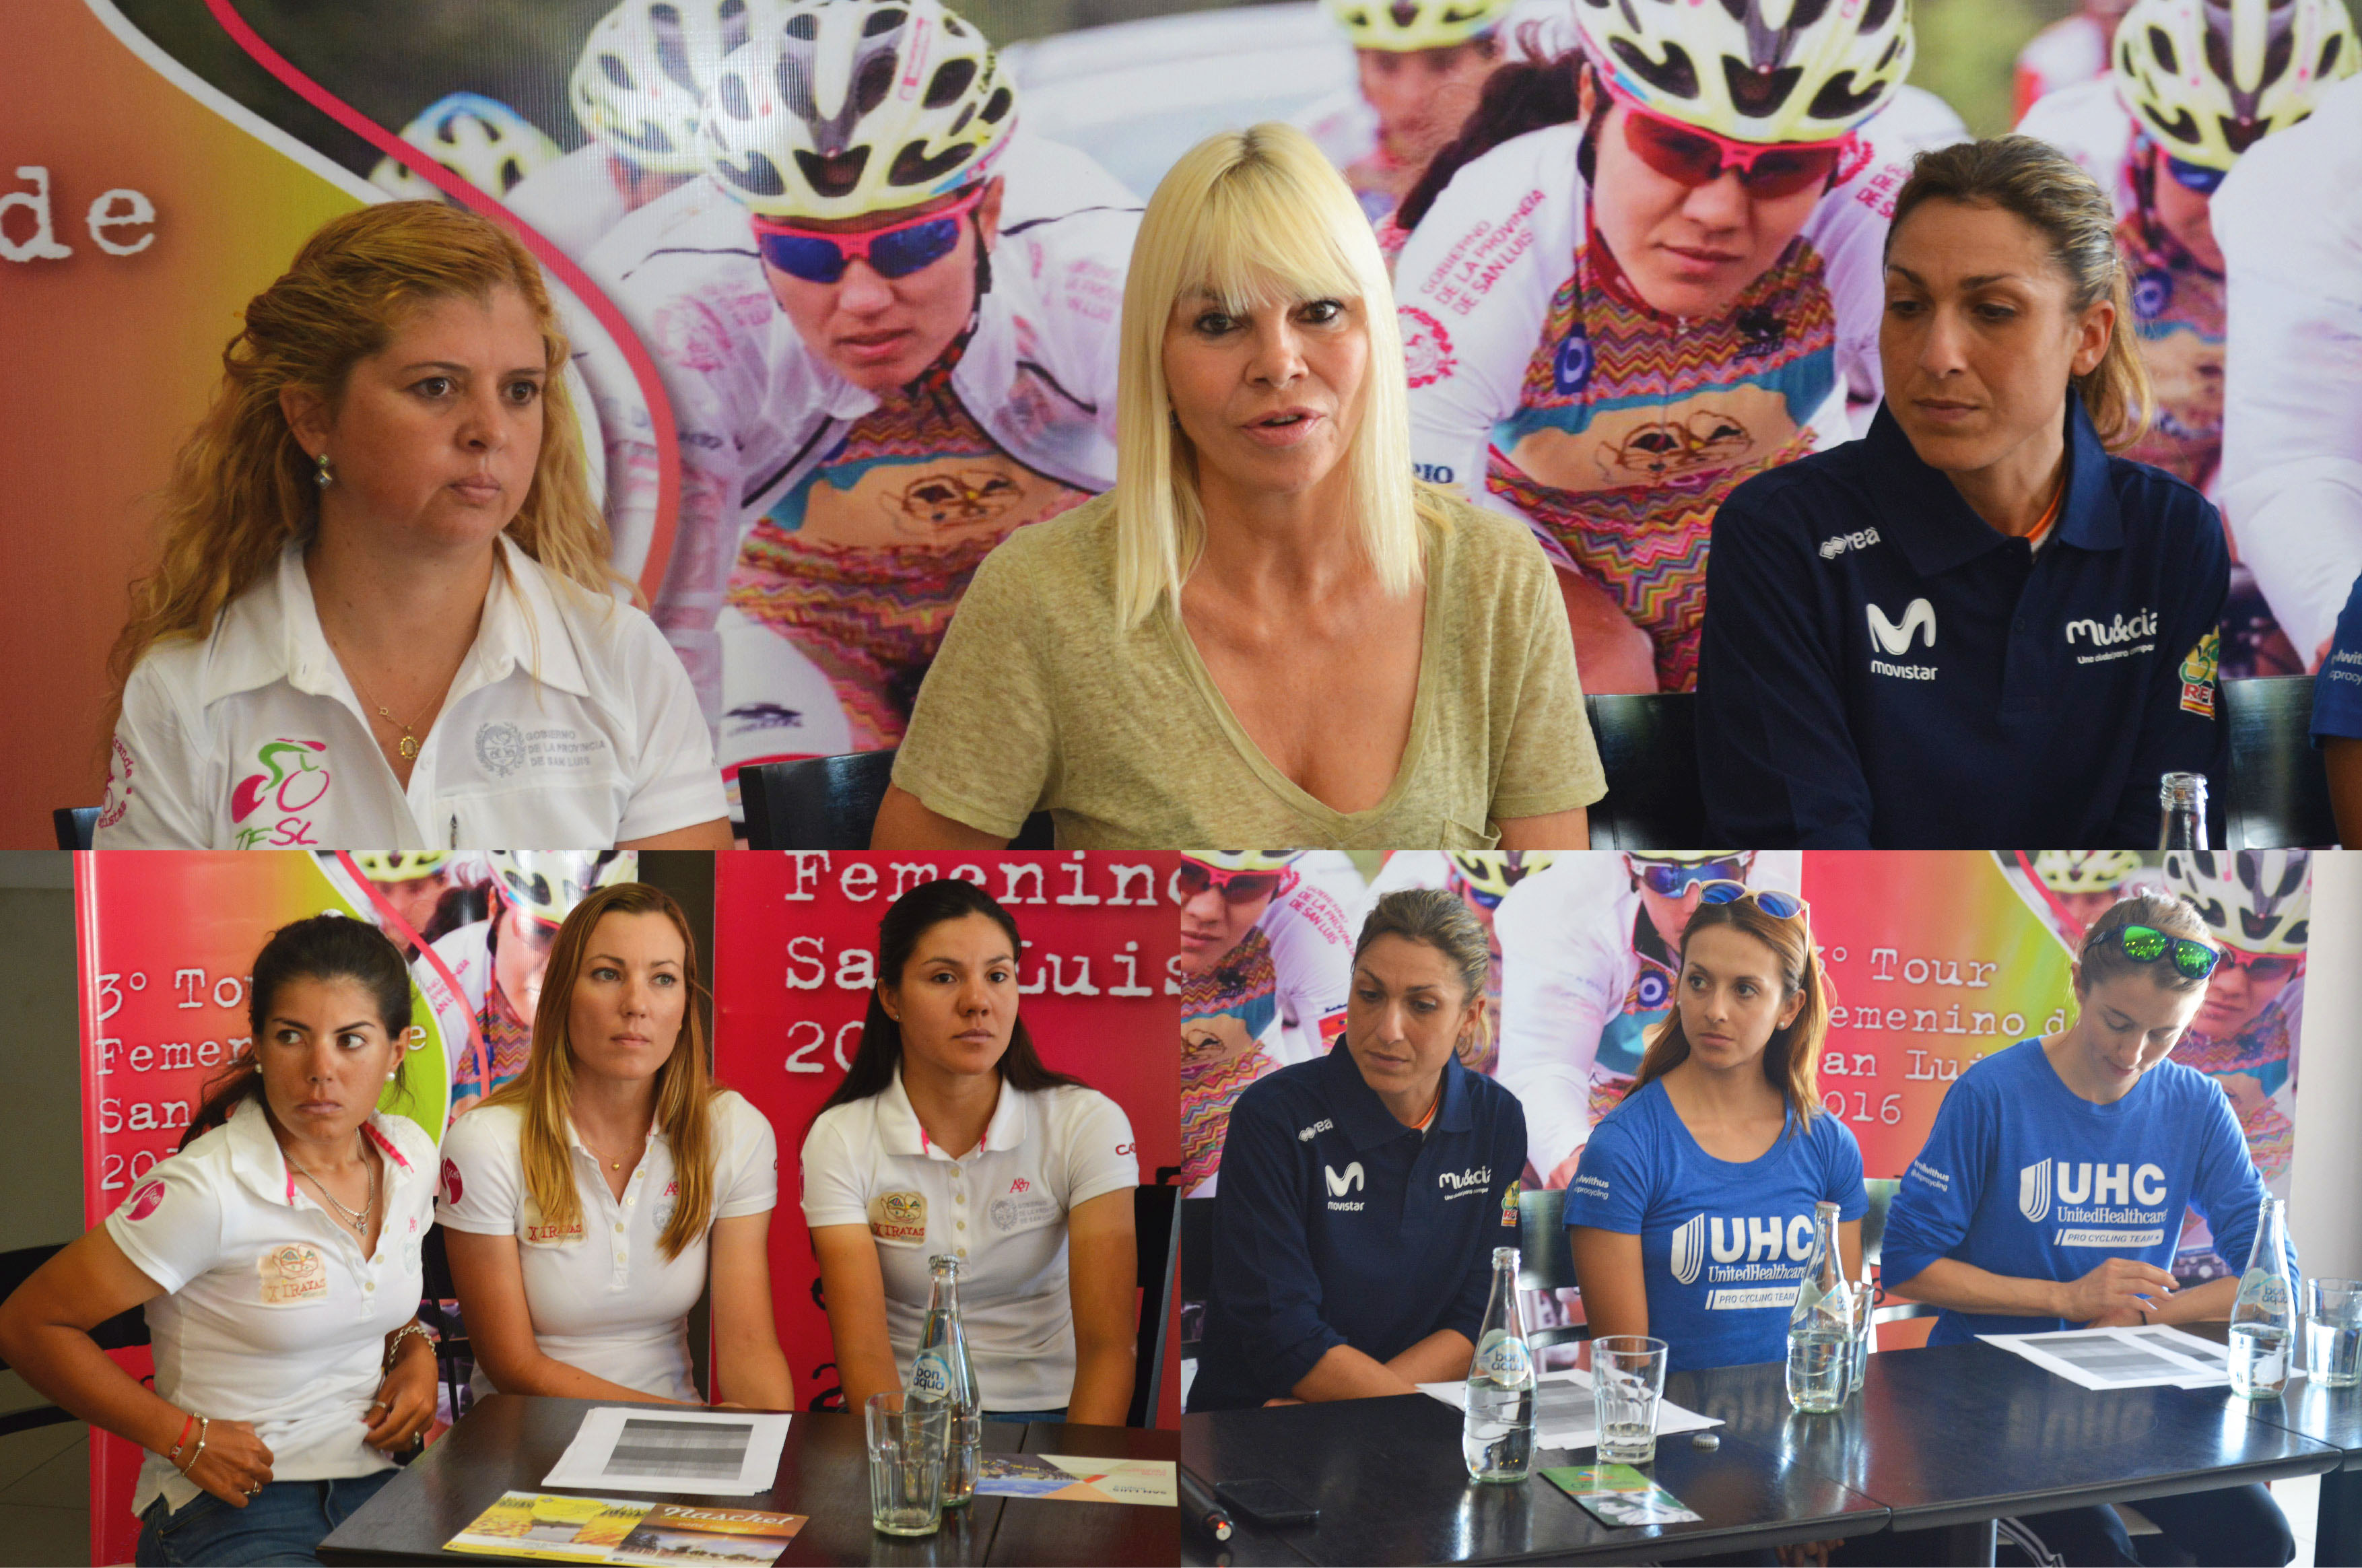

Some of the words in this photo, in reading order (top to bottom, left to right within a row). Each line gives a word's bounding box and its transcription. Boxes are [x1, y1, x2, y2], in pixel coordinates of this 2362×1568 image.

[0, 166, 156, 262] de
[1471, 261, 1506, 295] SAN
[1870, 659, 1938, 681] movistar
[786, 936, 878, 990] Sa
[1870, 947, 1998, 988] Tour
[174, 968, 252, 1009] To
[1829, 1002, 2026, 1037] emenino
[409, 1025, 427, 1050] e
[1822, 1052, 1878, 1077] an
[99, 1098, 192, 1134] San
[1822, 1090, 1902, 1125] 016
[102, 1148, 178, 1191] 20
[2058, 1162, 2167, 1206] UHC
[1327, 1201, 1365, 1211] movistar
[2057, 1206, 2169, 1225] UnitedHealthcare
[1710, 1214, 1815, 1264] UHC
[2068, 1233, 2087, 1241] PRO
[2088, 1233, 2128, 1243] CYCLING
[2130, 1234, 2153, 1243] TEAM
[1719, 1294, 1737, 1304] PRO
[1739, 1293, 1773, 1303] CYCLING
[1775, 1292, 1795, 1301] TEAM
[2262, 1295, 2288, 1305] aqua
[2265, 1285, 2285, 1295] bon
[914, 1377, 945, 1391] aqua
[916, 1365, 939, 1380] bon
